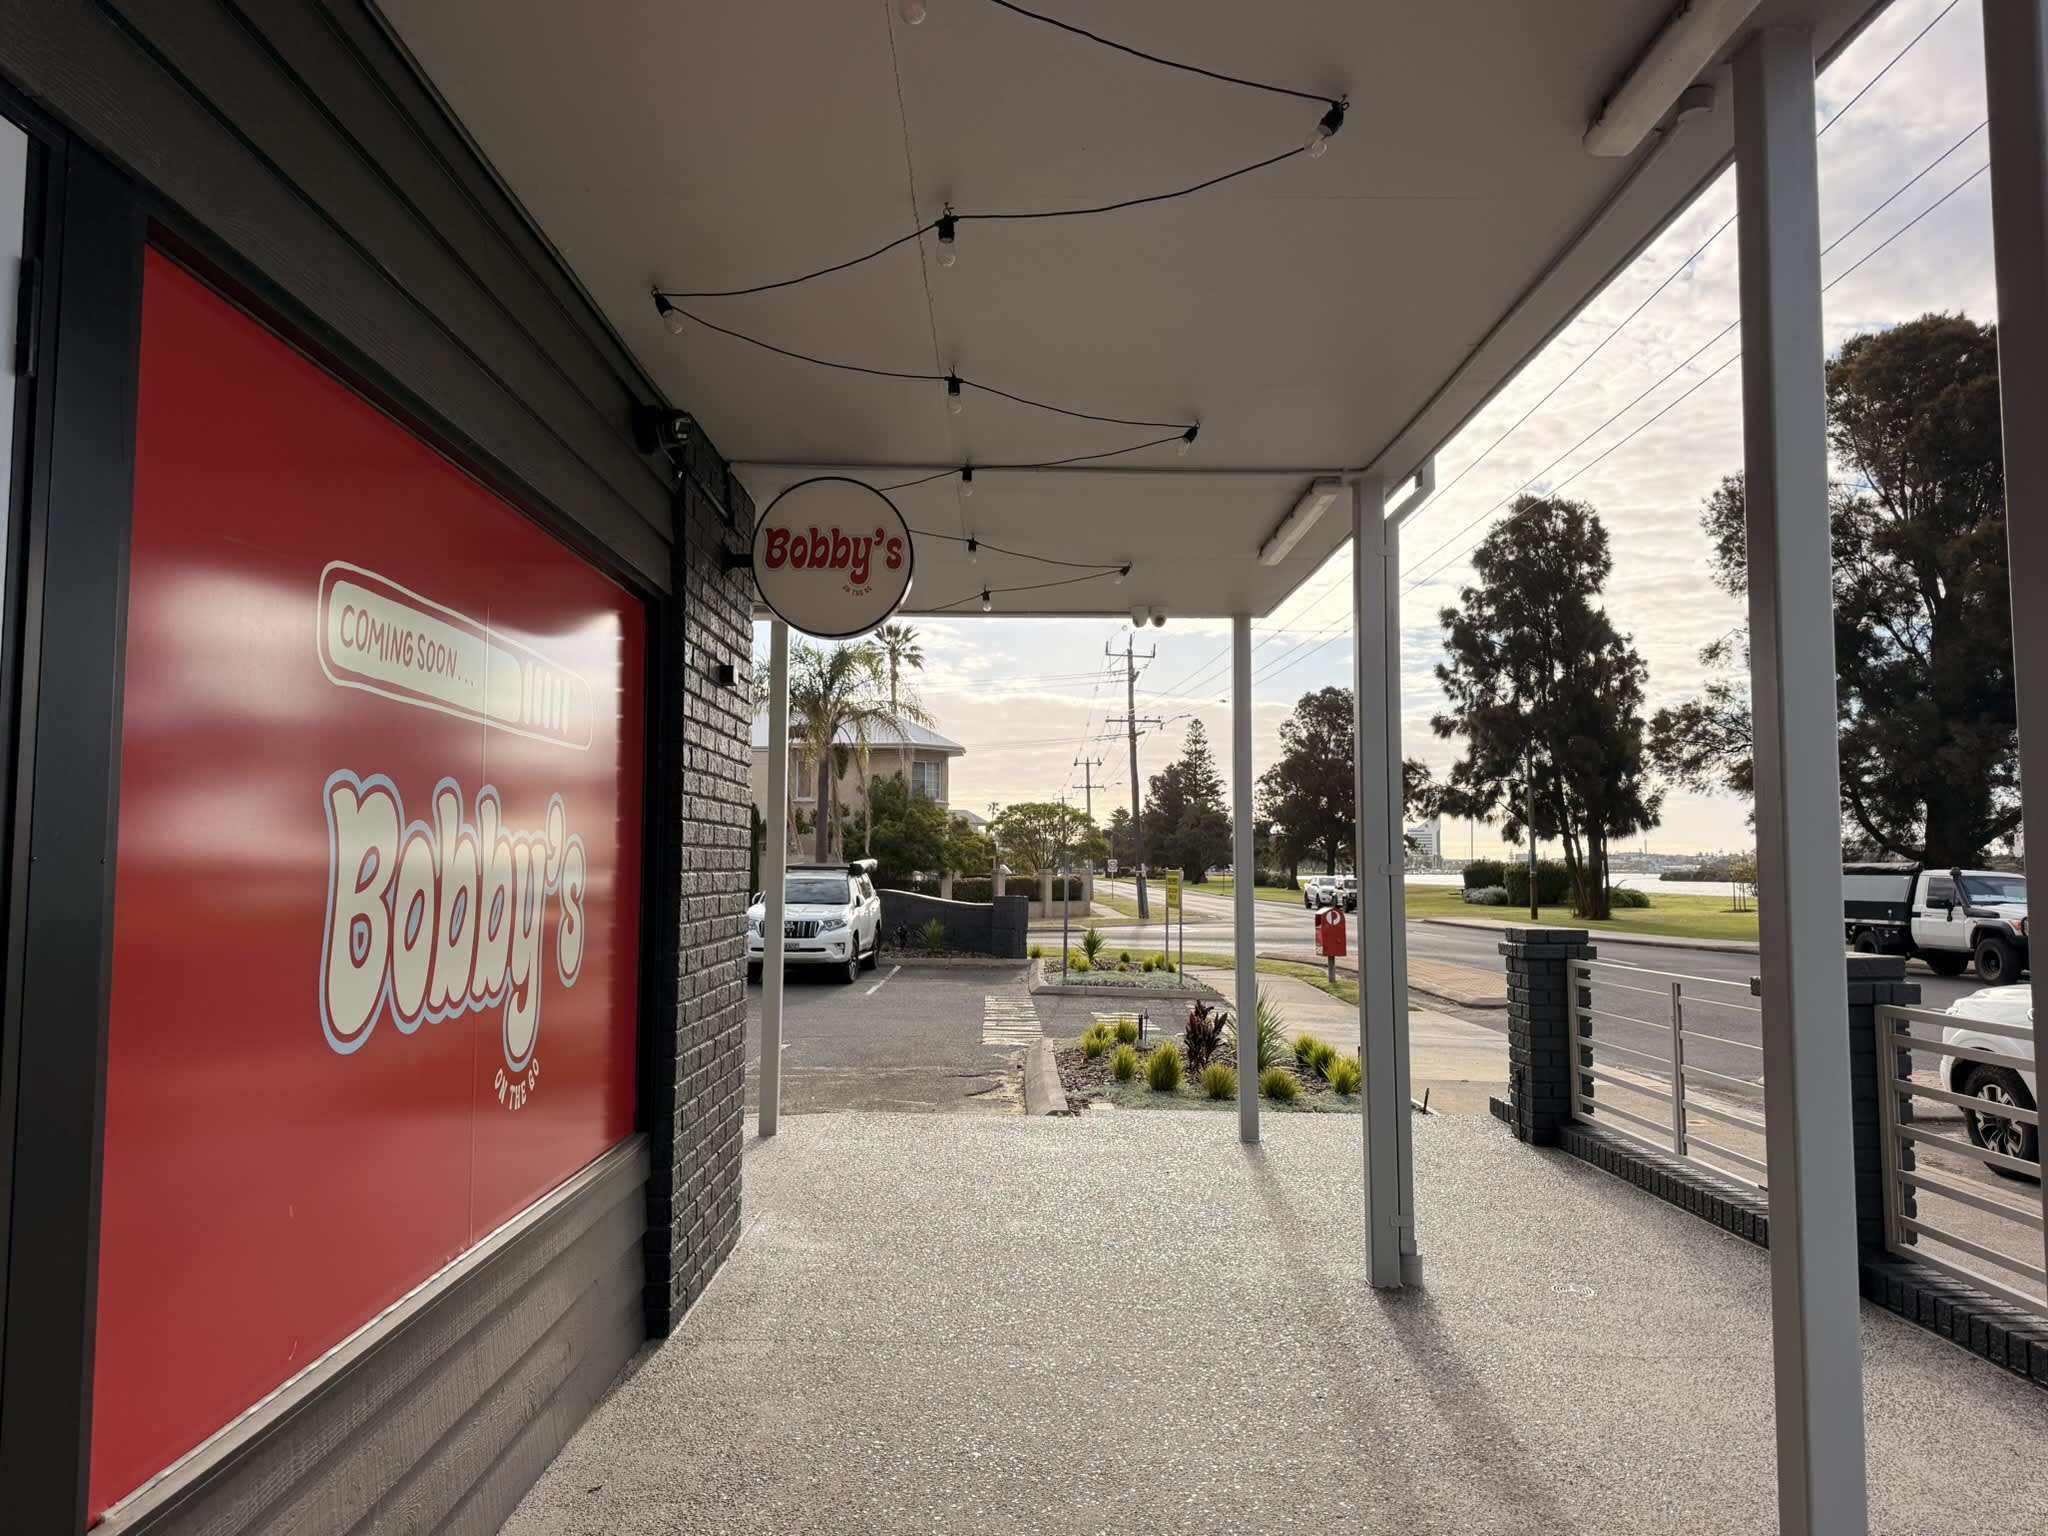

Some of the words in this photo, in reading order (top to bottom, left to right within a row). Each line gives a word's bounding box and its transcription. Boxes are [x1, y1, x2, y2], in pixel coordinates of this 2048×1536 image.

[765, 528, 902, 584] Bobby's
[340, 604, 413, 669] COMING
[320, 769, 586, 1071] Bobby's
[494, 1068, 508, 1104] ON
[509, 1073, 527, 1110] THE
[528, 1058, 540, 1092] GO
